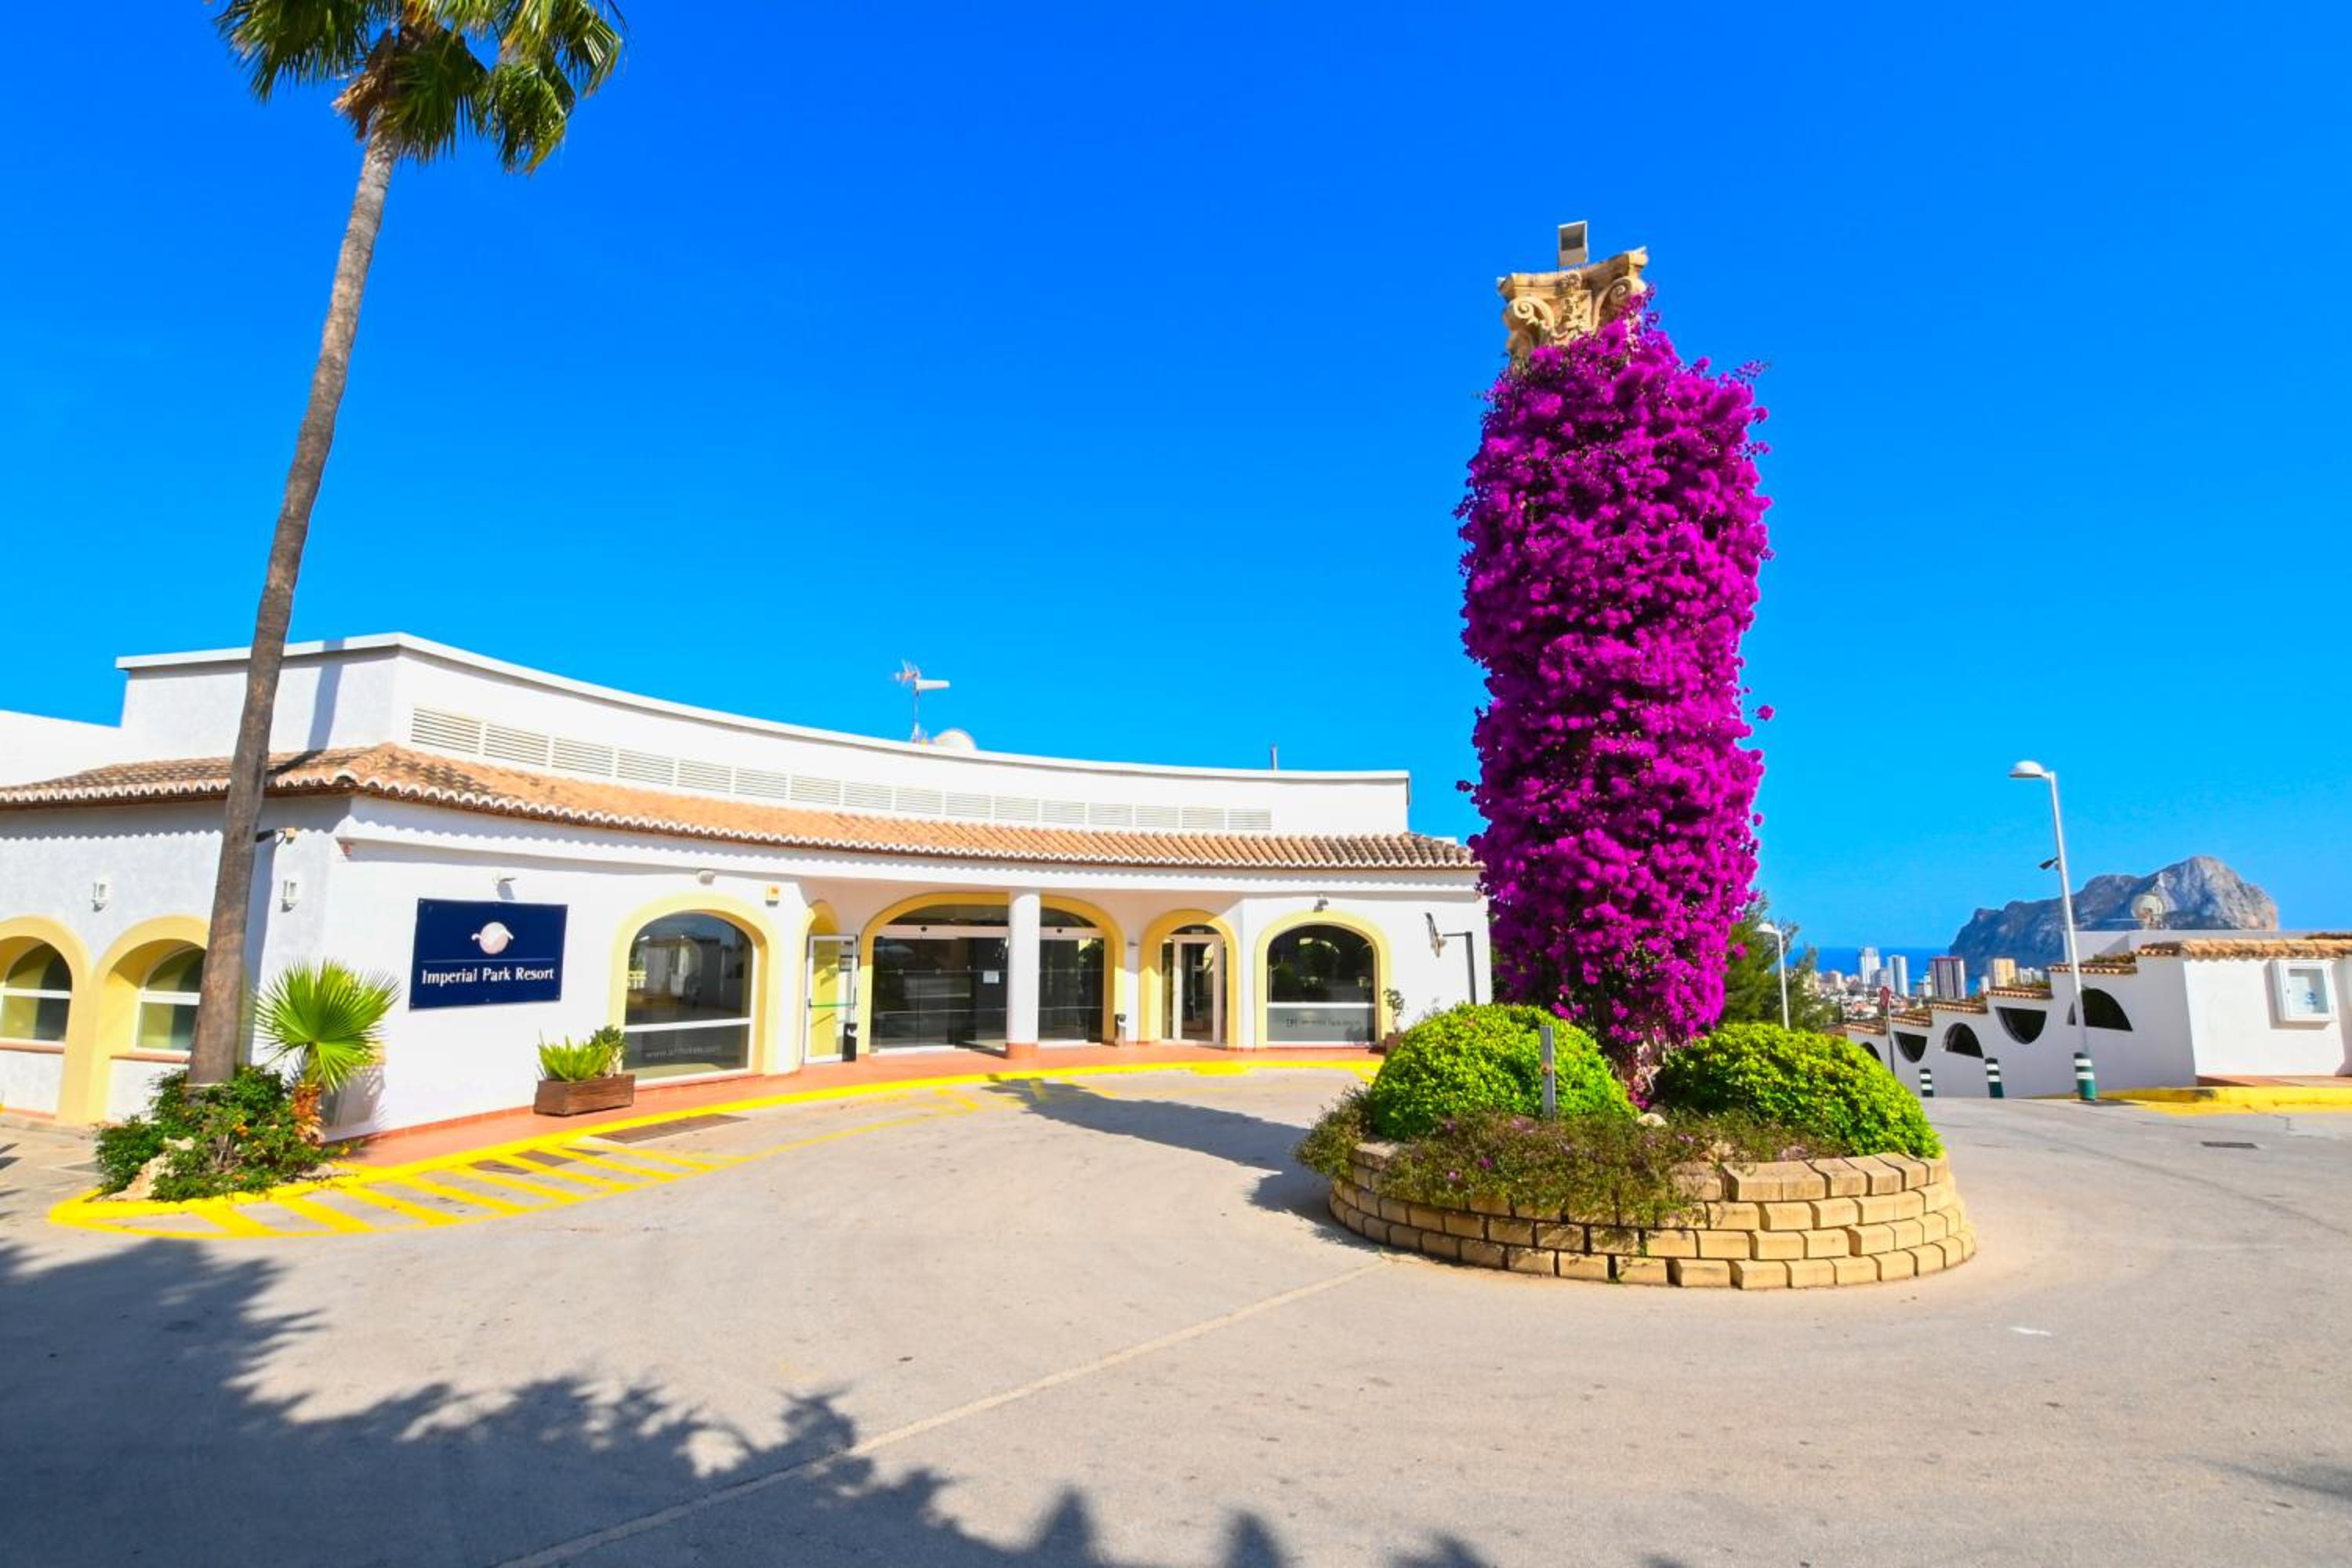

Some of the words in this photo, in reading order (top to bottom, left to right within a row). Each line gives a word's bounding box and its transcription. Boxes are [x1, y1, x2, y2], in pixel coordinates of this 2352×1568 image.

[422, 967, 477, 987] Imperial
[482, 967, 510, 982] Park
[515, 967, 554, 980] Resort
